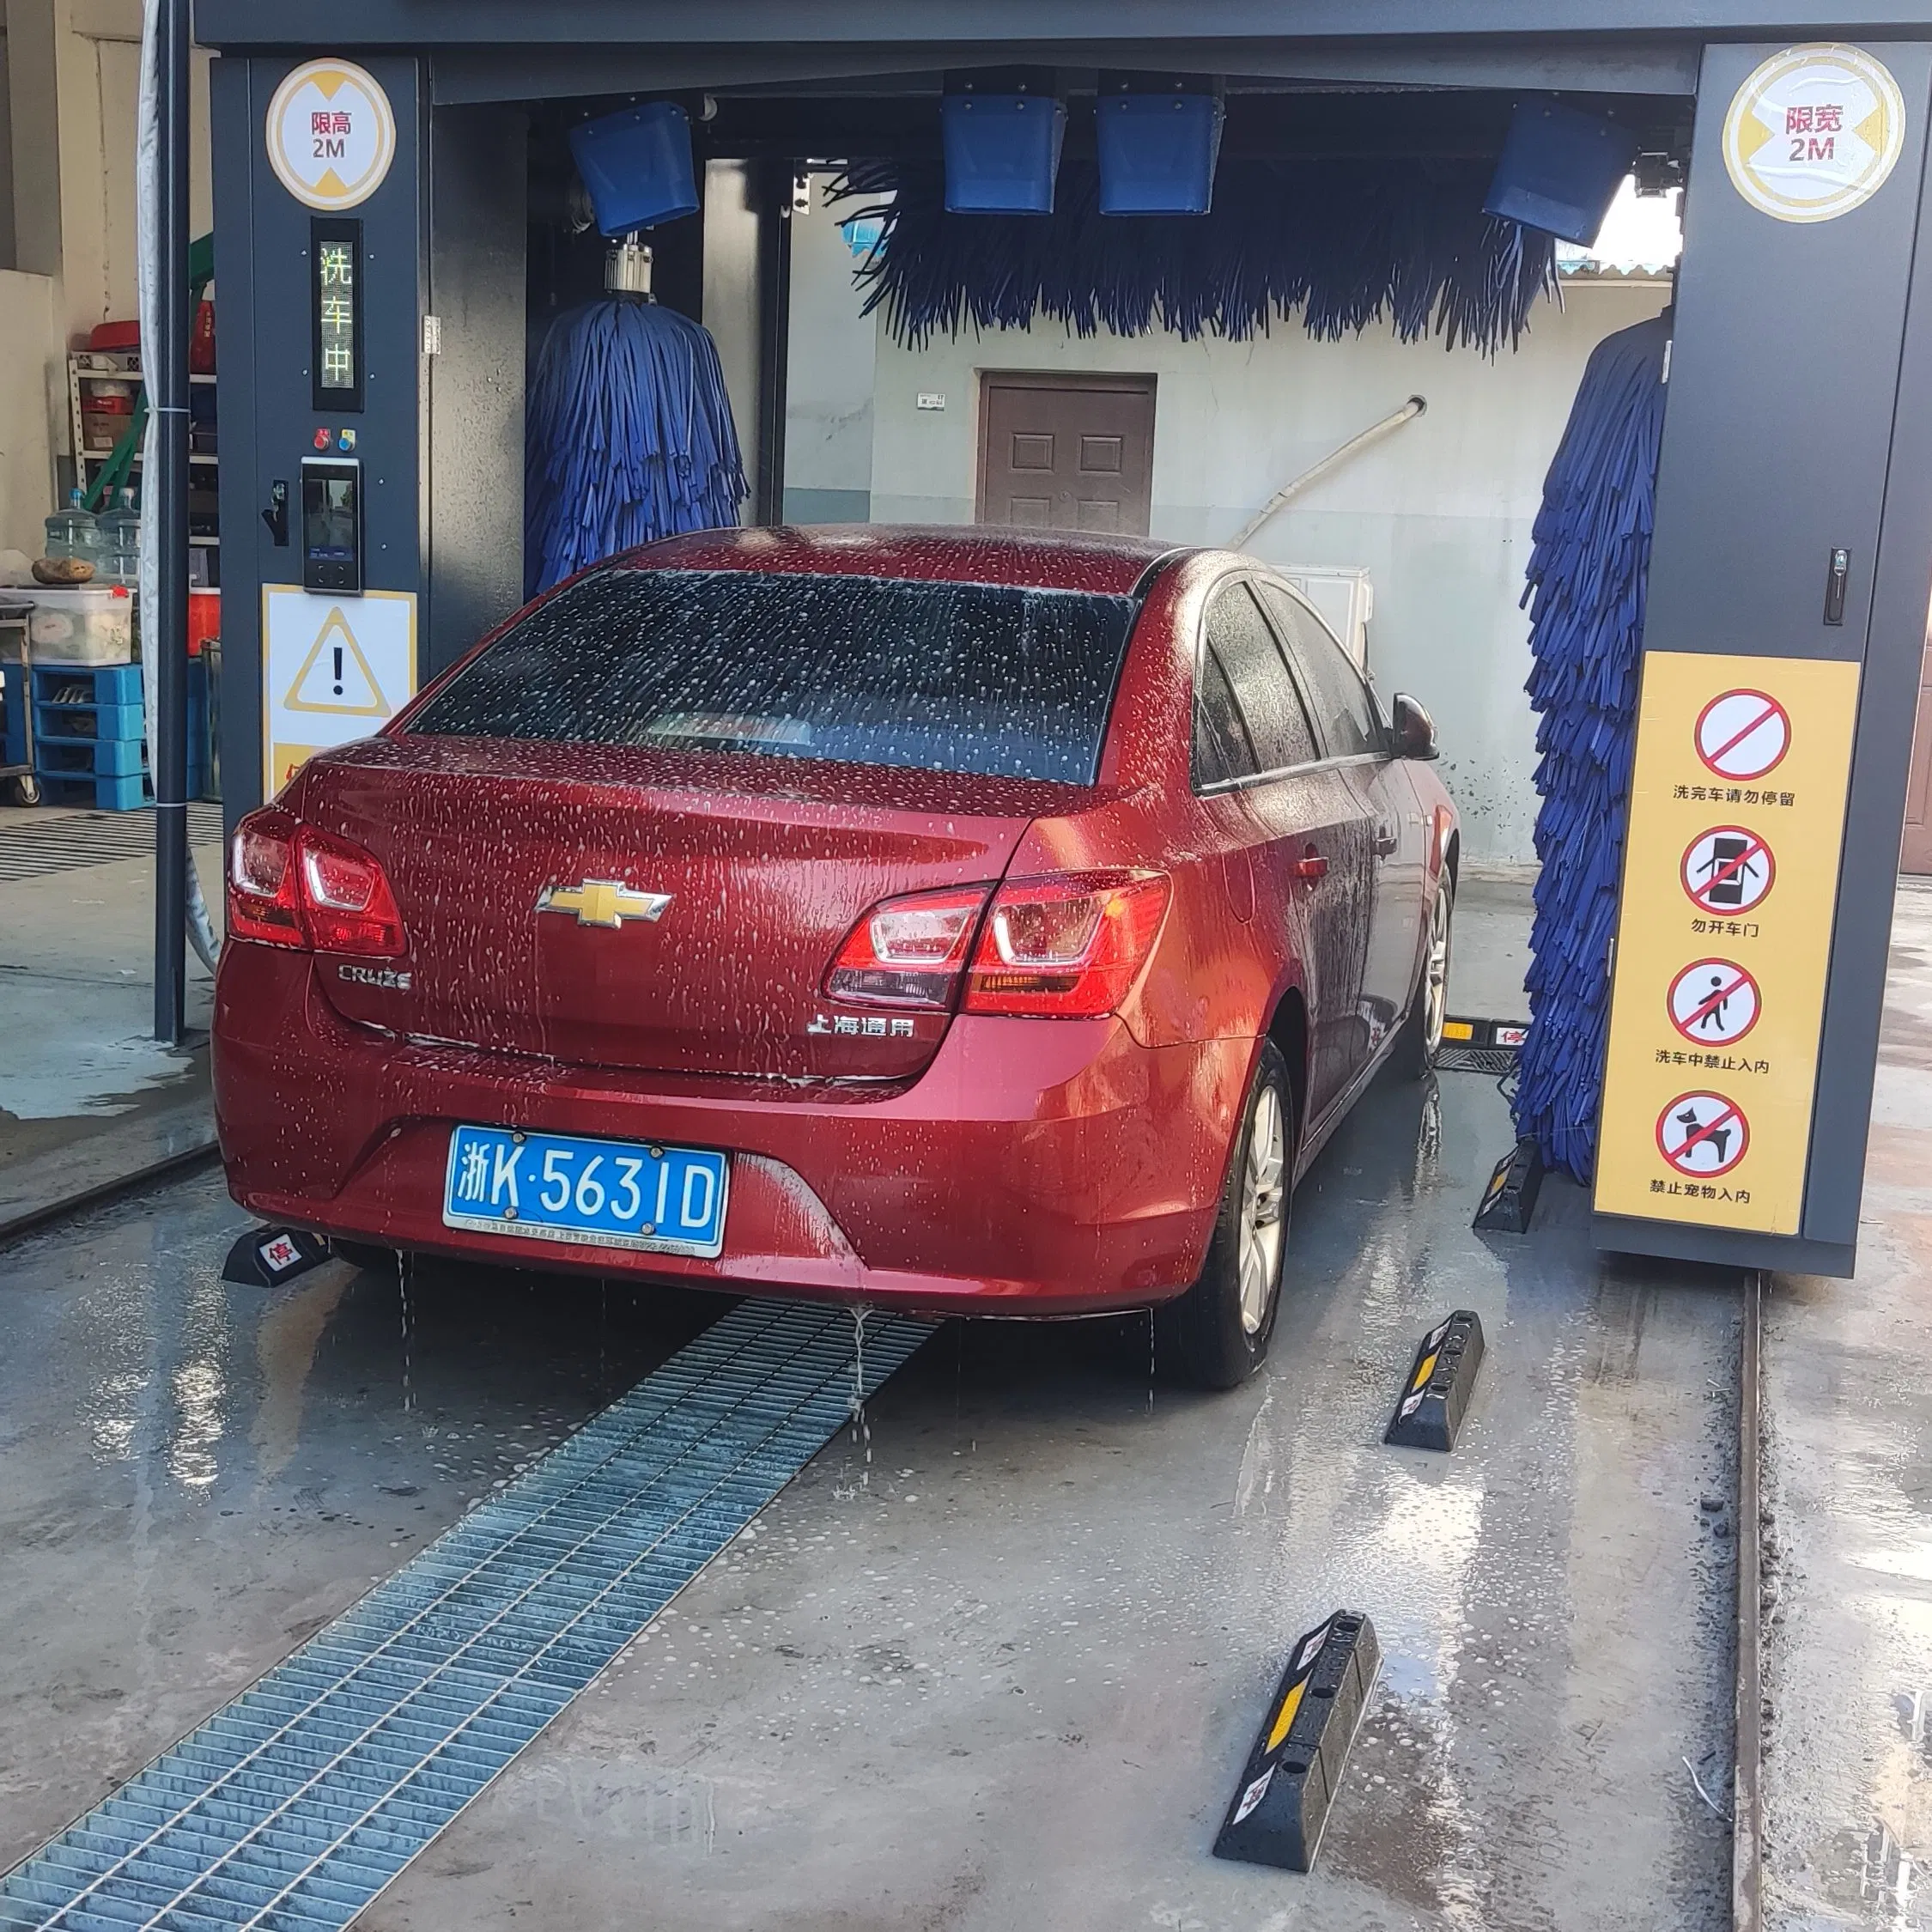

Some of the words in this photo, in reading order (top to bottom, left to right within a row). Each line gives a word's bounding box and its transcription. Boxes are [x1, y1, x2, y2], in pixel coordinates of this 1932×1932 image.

[311, 111, 352, 135] 限高
[1785, 103, 1844, 135] 限宽
[313, 138, 345, 158] 2M
[1789, 137, 1835, 161] 2M
[320, 247, 353, 381] 洗车中
[1673, 784, 1795, 807] 洗完车请勿停留
[1691, 918, 1759, 938] 勿开车门
[338, 963, 412, 989] CRUZE
[807, 1013, 914, 1037] 上海通用
[1656, 1048, 1770, 1074] 洗车中禁止入内
[1649, 1178, 1751, 1204] 禁止宠物入内
